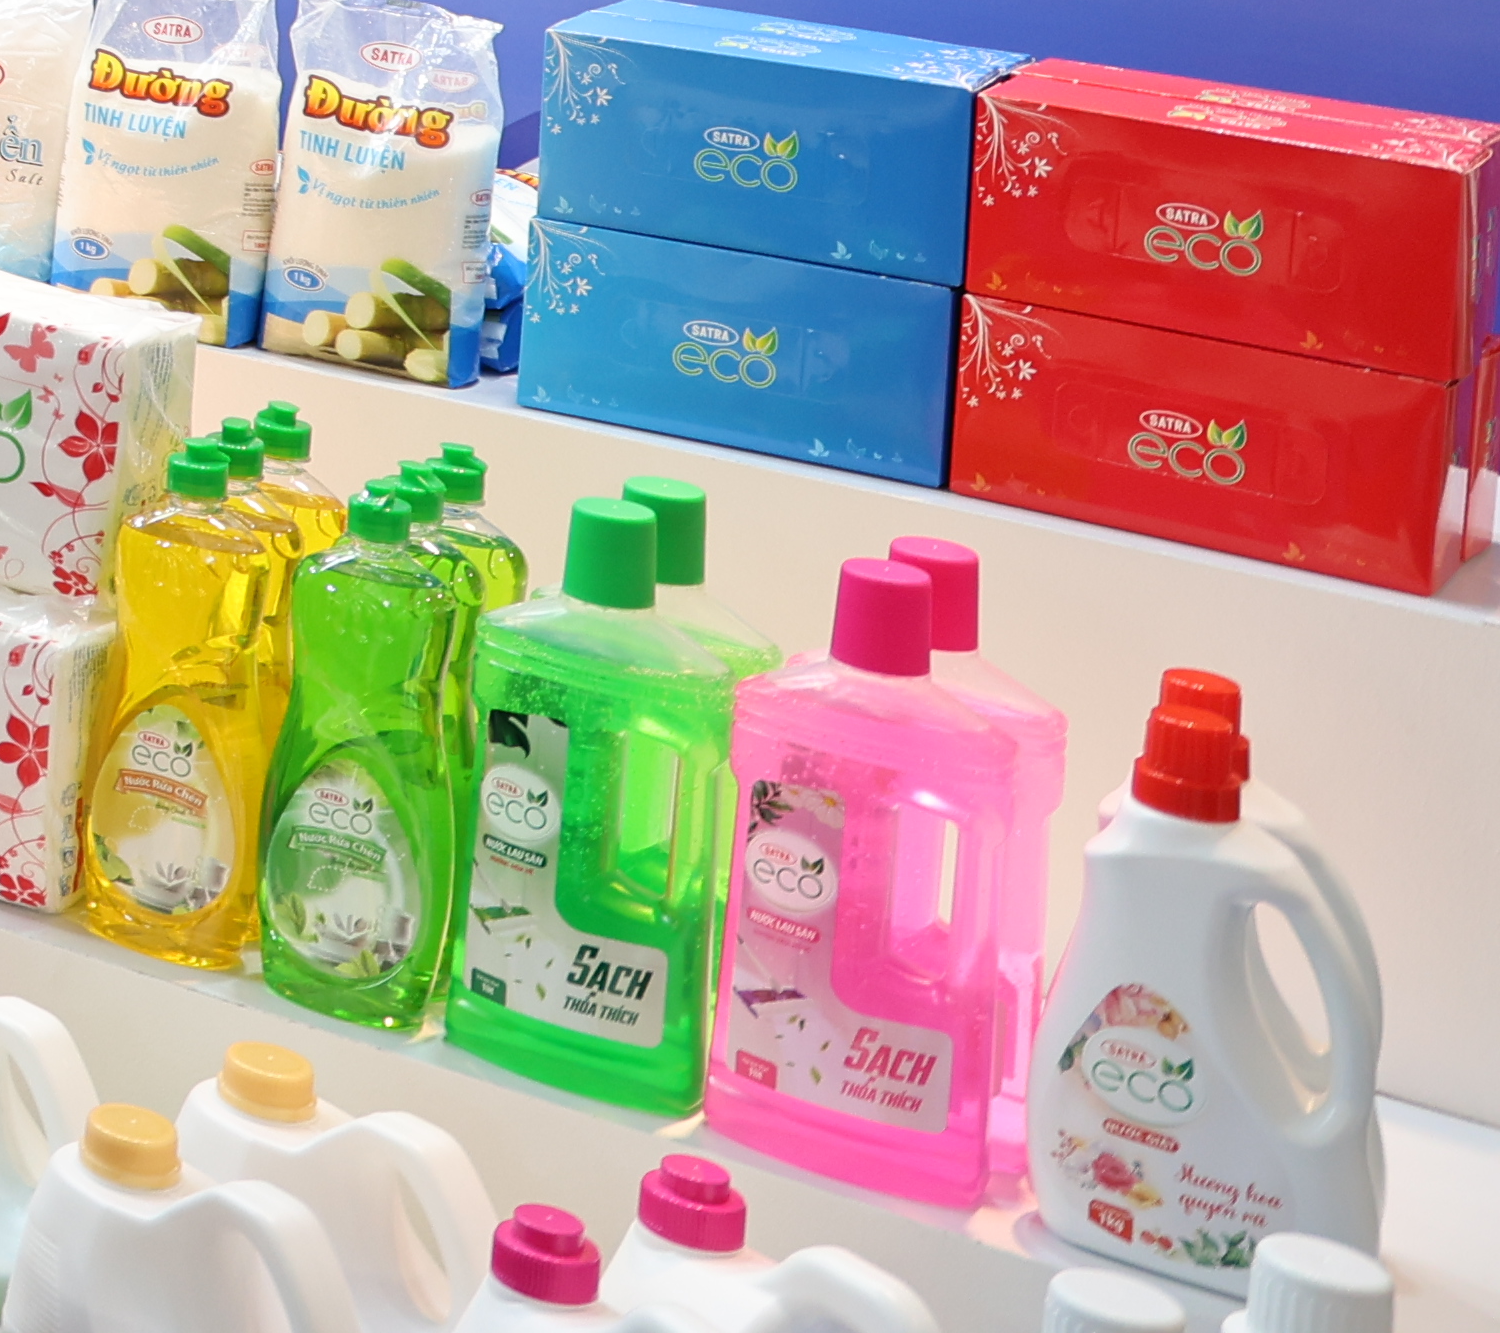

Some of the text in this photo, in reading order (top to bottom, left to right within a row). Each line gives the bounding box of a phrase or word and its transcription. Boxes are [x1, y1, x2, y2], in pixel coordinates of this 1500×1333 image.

[153, 22, 192, 39] SATRA
[89, 48, 233, 118] Đường
[84, 102, 187, 143] TINH LUYỆN
[5, 167, 44, 187] Salt
[1164, 206, 1210, 229] SATRA
[1143, 224, 1263, 277] eco
[567, 944, 652, 1000] SẠCH
[599, 1005, 639, 1027] THÍCH
